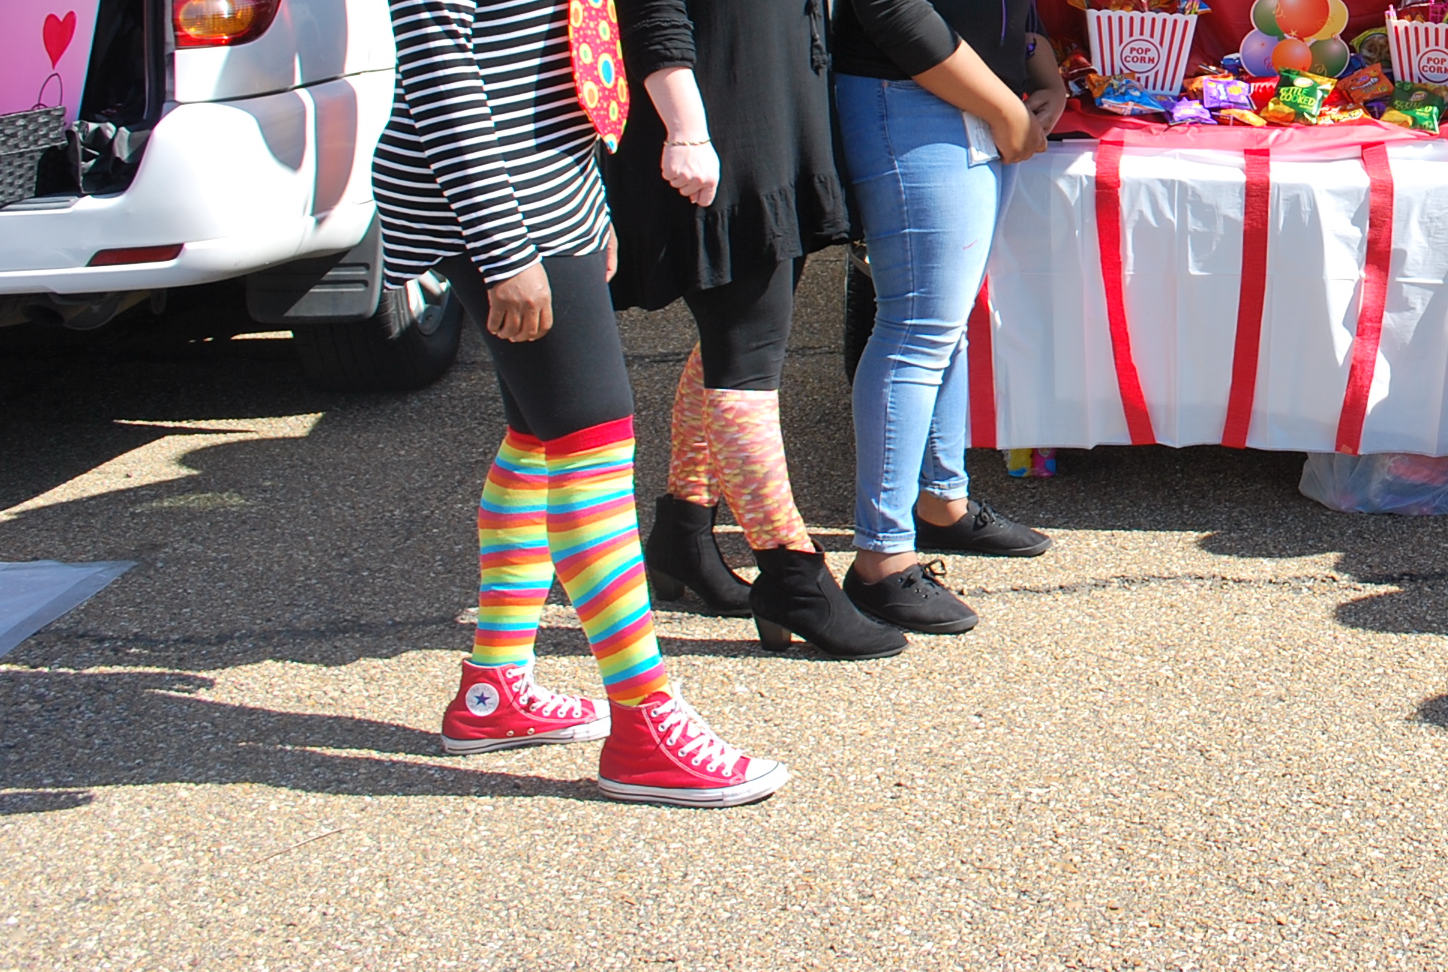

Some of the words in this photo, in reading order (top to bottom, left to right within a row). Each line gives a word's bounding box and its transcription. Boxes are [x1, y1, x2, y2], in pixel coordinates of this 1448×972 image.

[1129, 46, 1151, 56] POP
[1123, 55, 1155, 65] CORN
[1426, 56, 1447, 65] POP
